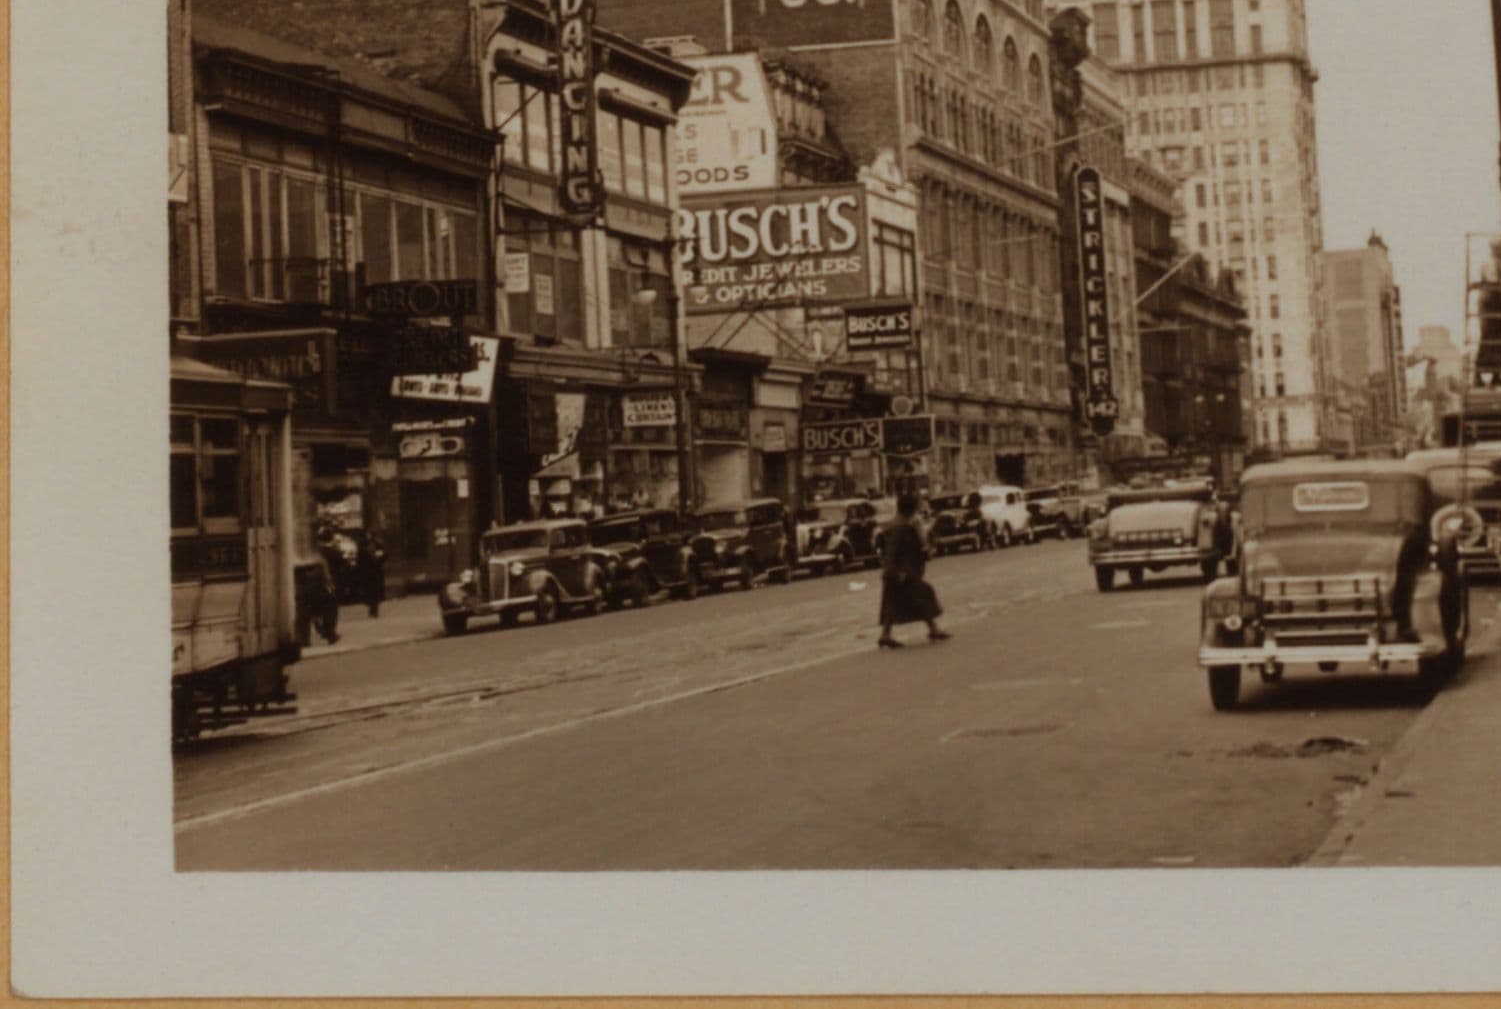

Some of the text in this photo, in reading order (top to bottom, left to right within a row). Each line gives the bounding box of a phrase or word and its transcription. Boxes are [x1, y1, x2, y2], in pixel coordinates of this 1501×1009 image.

[678, 194, 860, 264] BUSCH'S
[742, 255, 863, 282] JEWELERS
[714, 279, 828, 304] OPTICIANS
[848, 311, 910, 333] BUSCH'S
[804, 421, 880, 450] BUSCH'S
